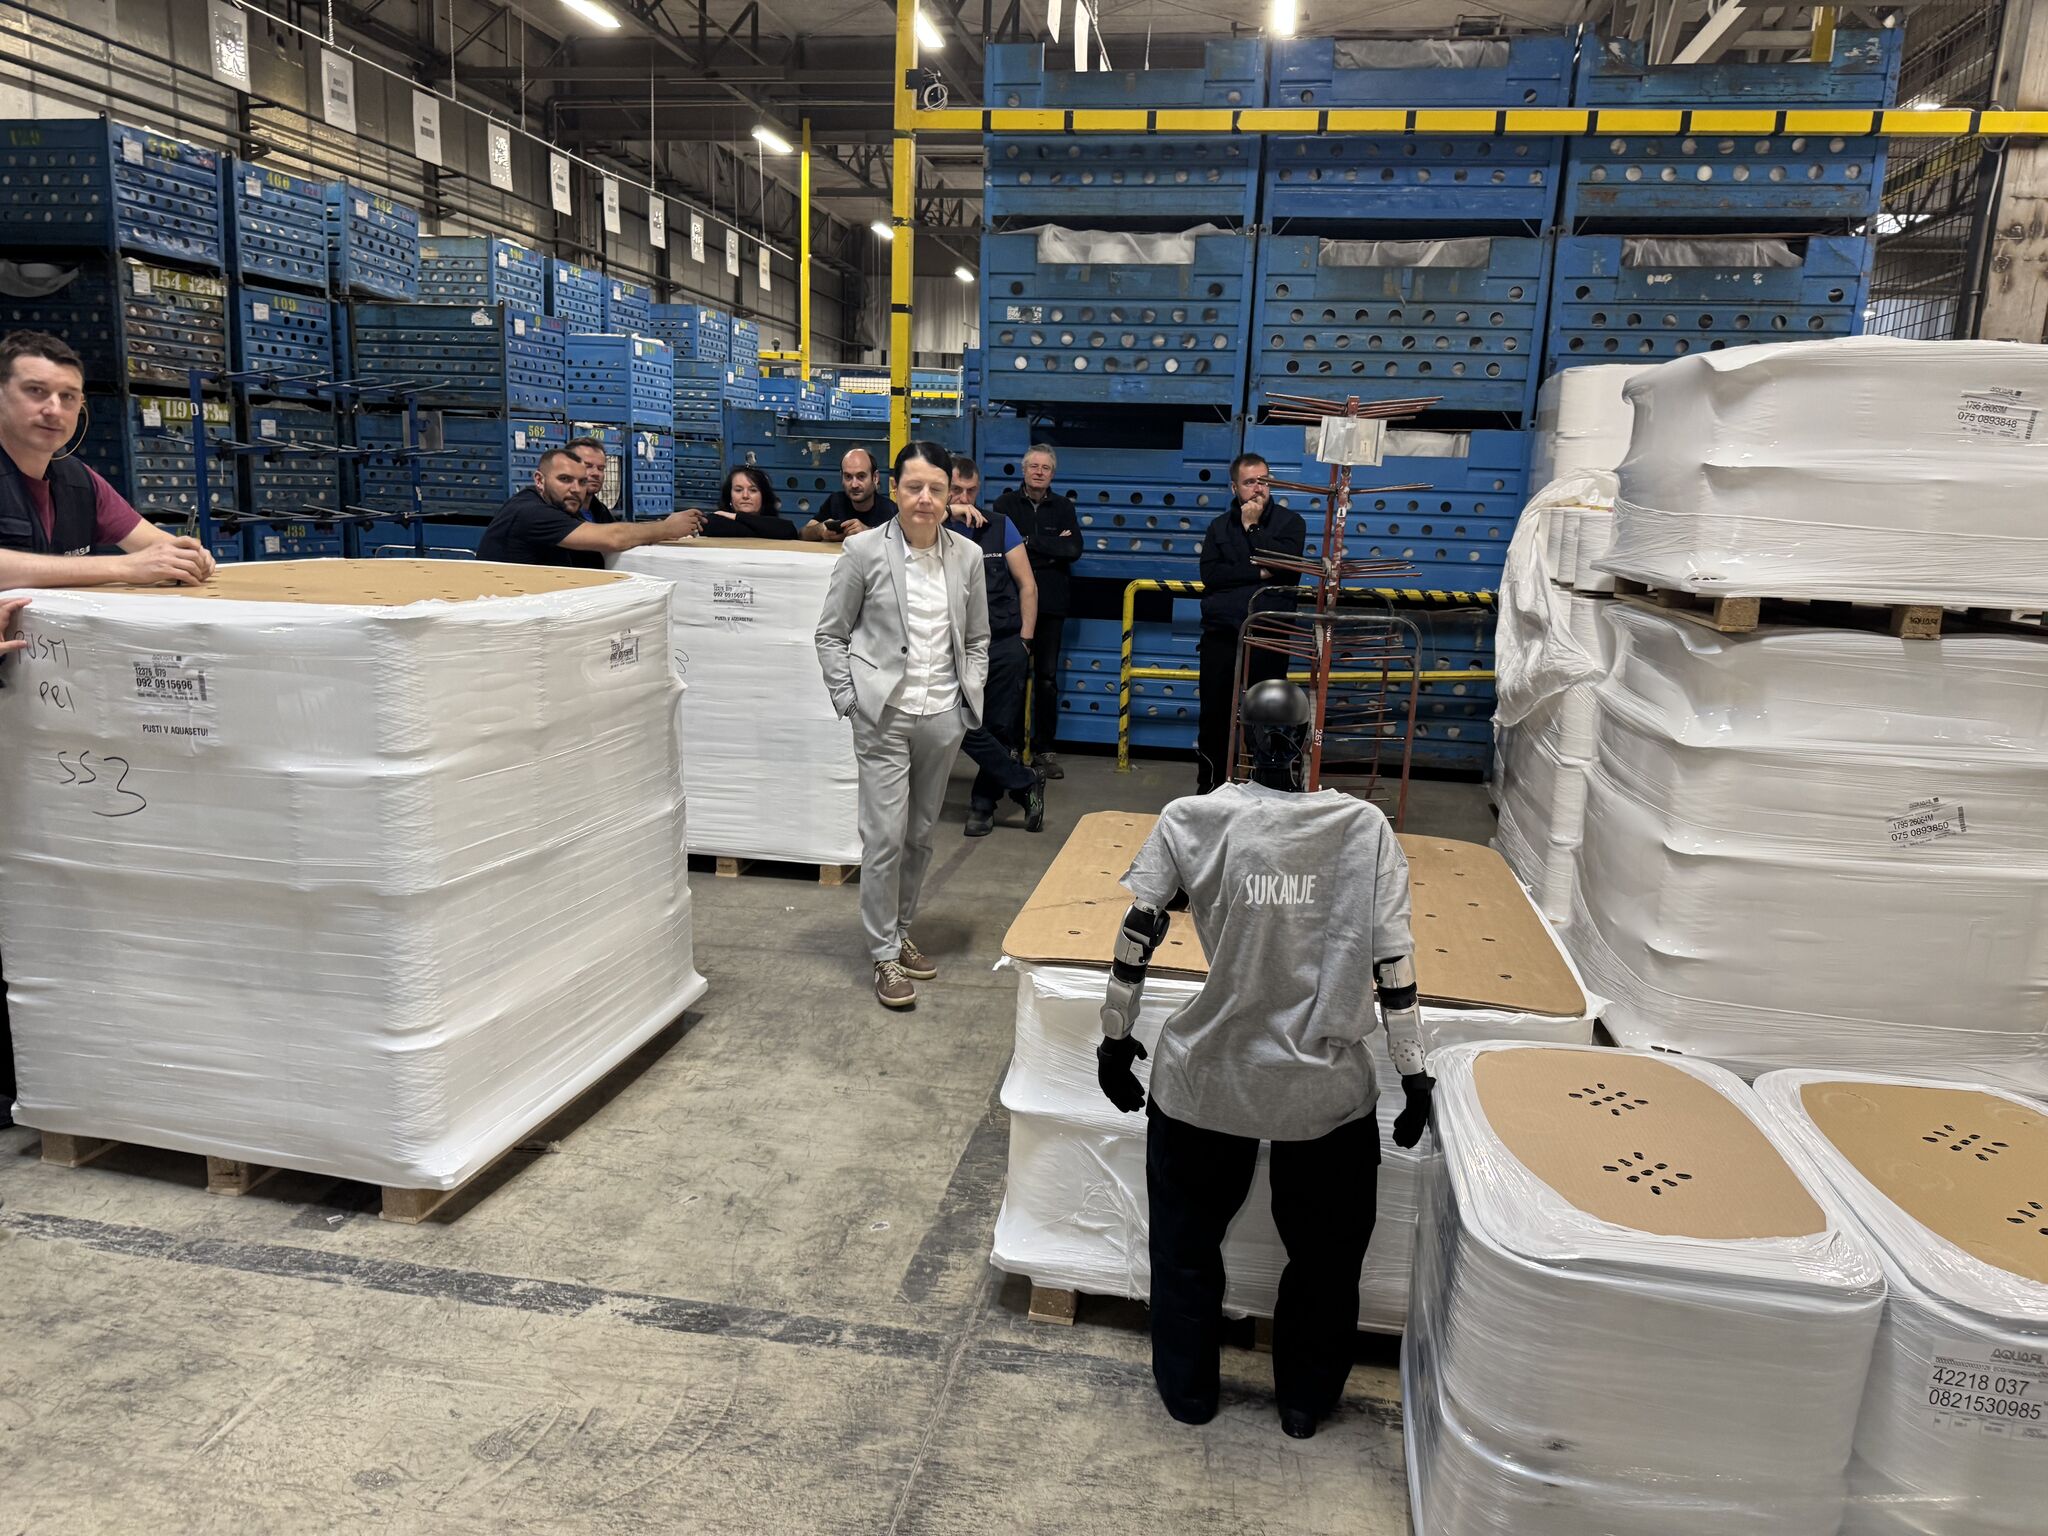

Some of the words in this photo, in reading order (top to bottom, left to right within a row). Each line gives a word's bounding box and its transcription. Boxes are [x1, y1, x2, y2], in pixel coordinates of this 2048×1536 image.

[1957, 411, 1976, 422] 075
[1977, 414, 2018, 429] 0893848
[527, 425, 546, 438] 562
[136, 677, 153, 688] 092
[142, 724, 162, 733] PUSTI
[1891, 831, 1909, 842] 075
[1910, 821, 1950, 837] 0893850
[1244, 873, 1317, 905] SUKANJE
[1932, 1368, 1990, 1391] 42218
[1994, 1377, 2030, 1397] 037
[1928, 1388, 2042, 1420] 0821530985
